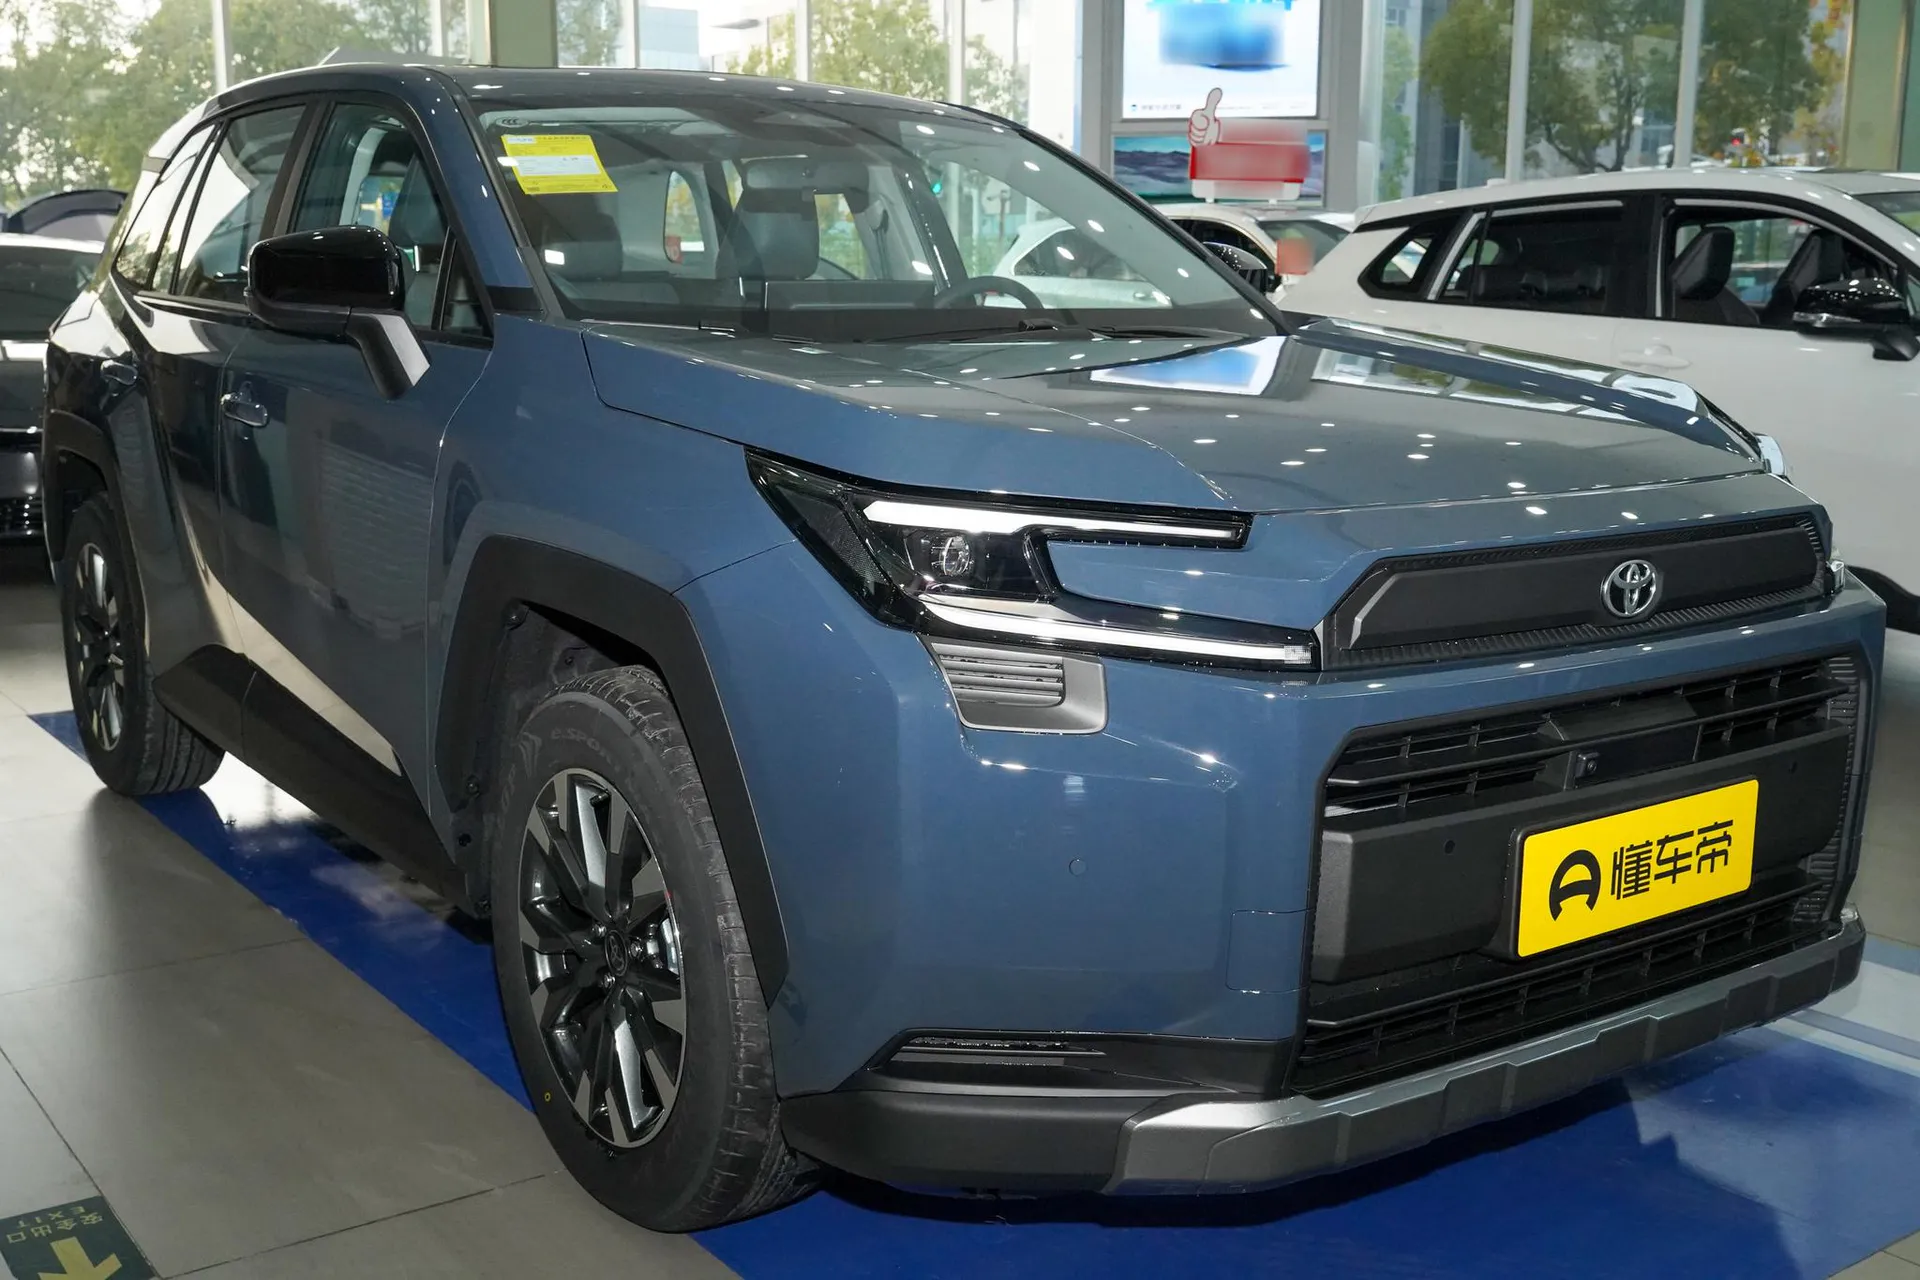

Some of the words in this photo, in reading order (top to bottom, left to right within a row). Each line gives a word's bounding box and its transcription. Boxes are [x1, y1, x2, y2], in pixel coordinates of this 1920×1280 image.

[1611, 820, 1734, 900] 懂车帝
[7, 1212, 103, 1243] 安全出口
[17, 1206, 86, 1229] EXIT
